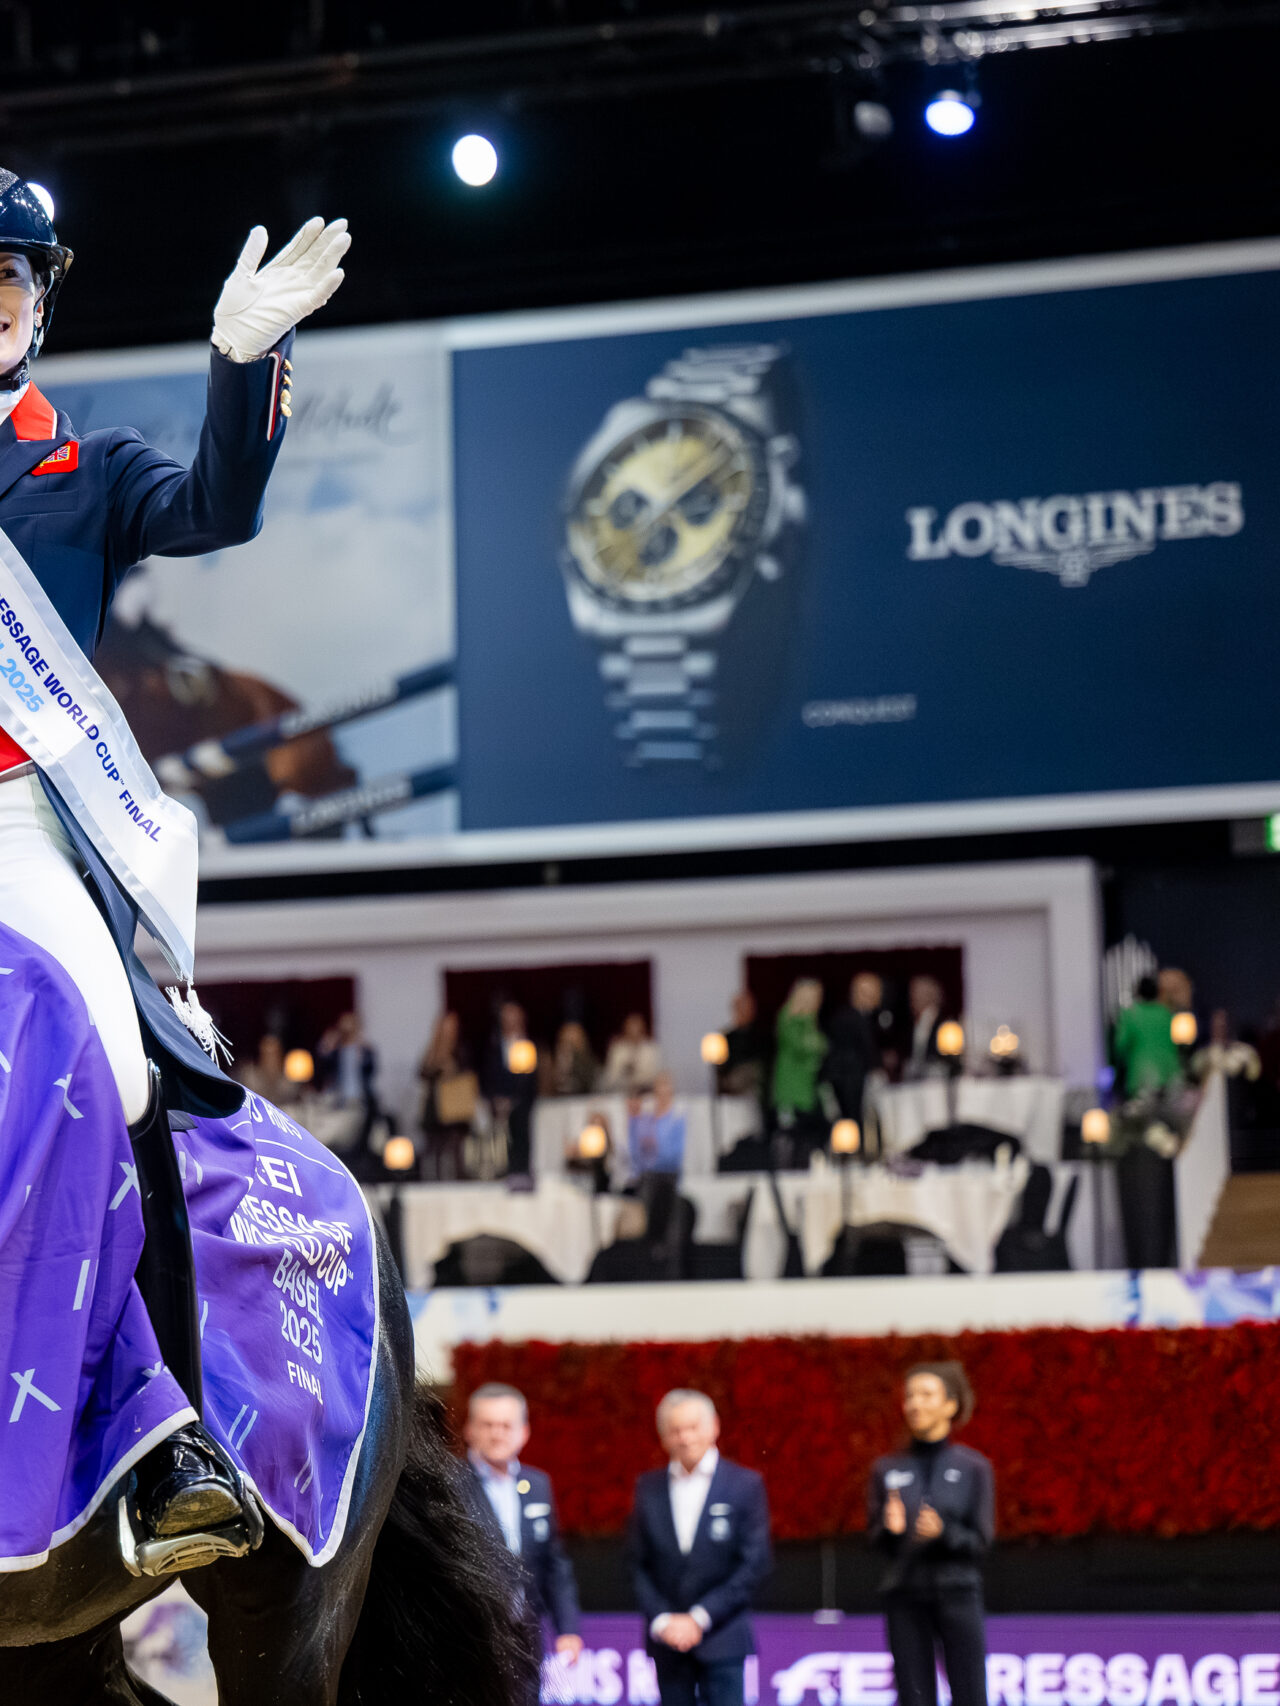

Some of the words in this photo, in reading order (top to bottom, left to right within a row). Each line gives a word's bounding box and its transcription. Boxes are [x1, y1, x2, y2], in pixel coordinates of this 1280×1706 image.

[905, 480, 1245, 561] LONGINES
[43, 672, 100, 741] WORLD
[118, 789, 162, 842] FINAL
[272, 1247, 323, 1328] BASEL
[279, 1299, 323, 1365] 2025
[286, 1359, 324, 1406] FINAL
[985, 1652, 1280, 1706] RESSAGE
